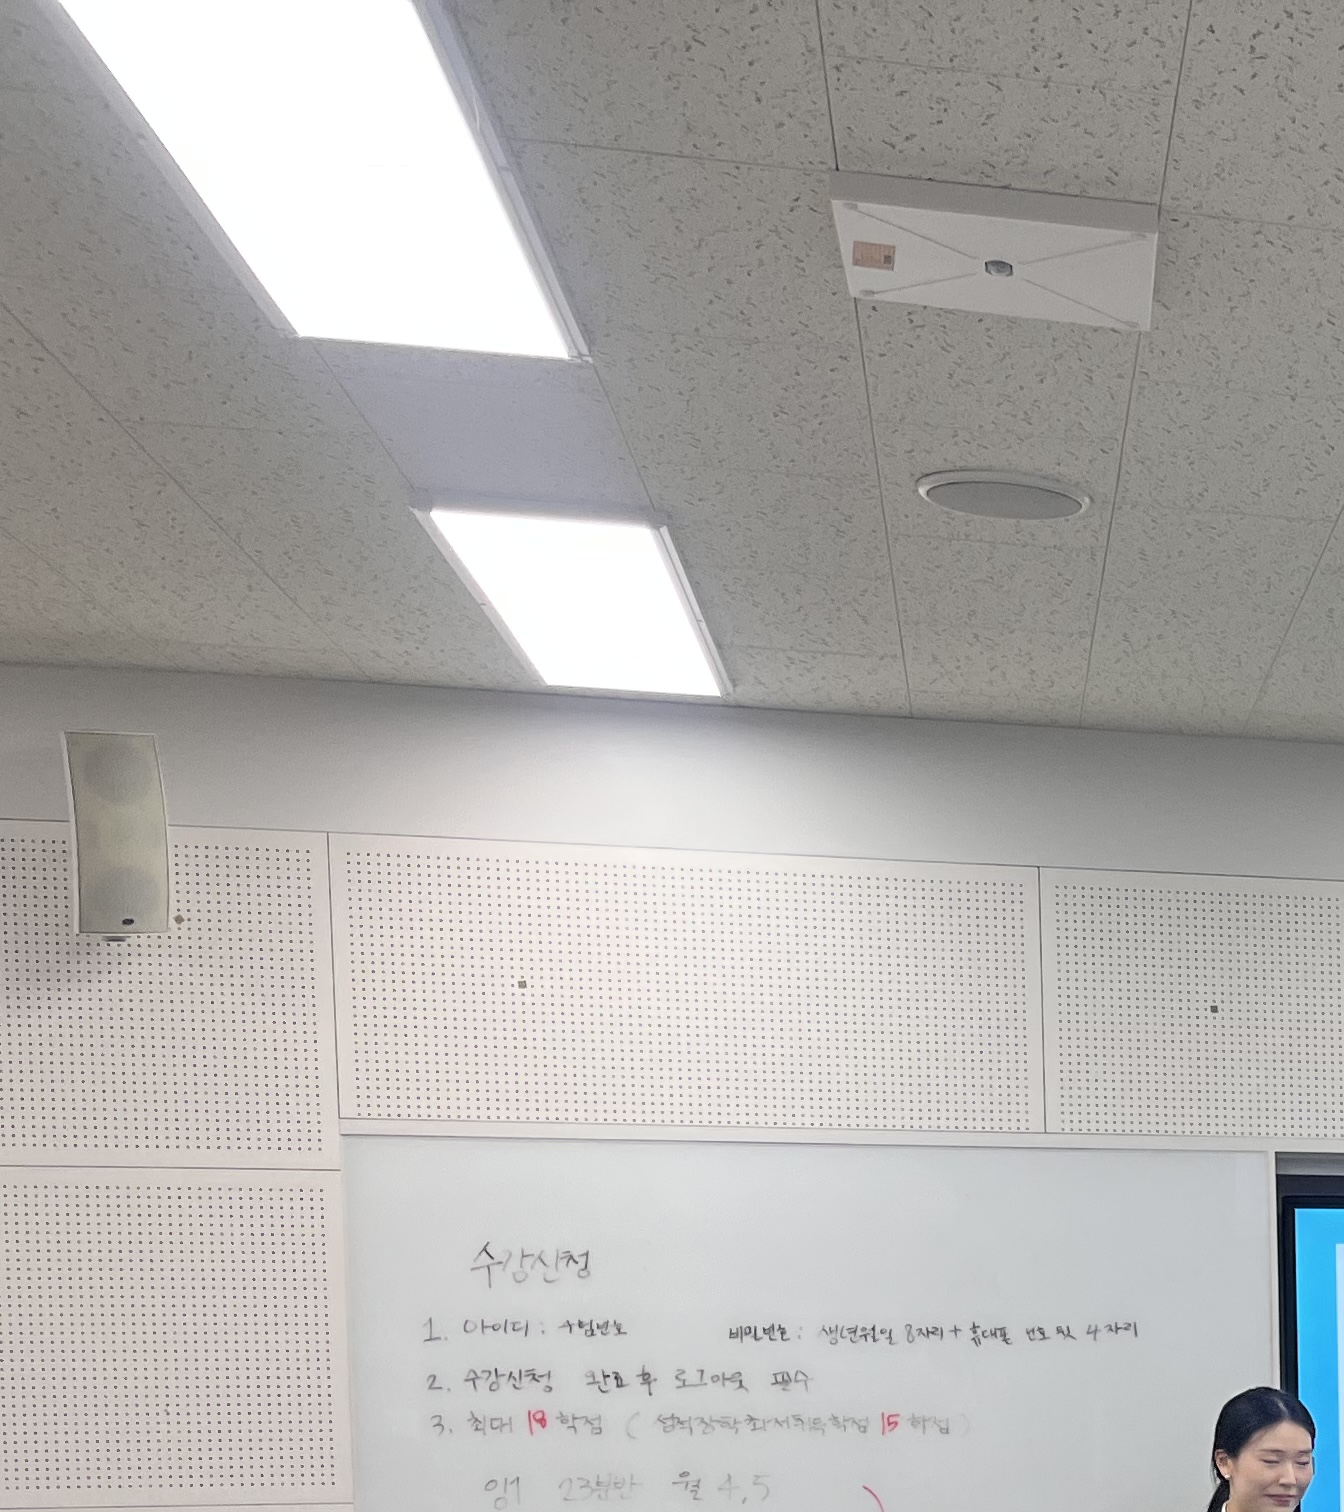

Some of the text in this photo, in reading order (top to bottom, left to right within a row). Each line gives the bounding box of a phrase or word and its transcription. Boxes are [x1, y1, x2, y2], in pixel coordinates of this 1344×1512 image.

[470, 1241, 592, 1289] 수강신청
[423, 1317, 449, 1342] 1.
[426, 1373, 452, 1393] 2.
[464, 1368, 555, 1394] 수강신청
[636, 1364, 659, 1397] 후
[528, 1410, 549, 1437] 18
[881, 1411, 901, 1437] 15
[672, 1470, 704, 1502] 월
